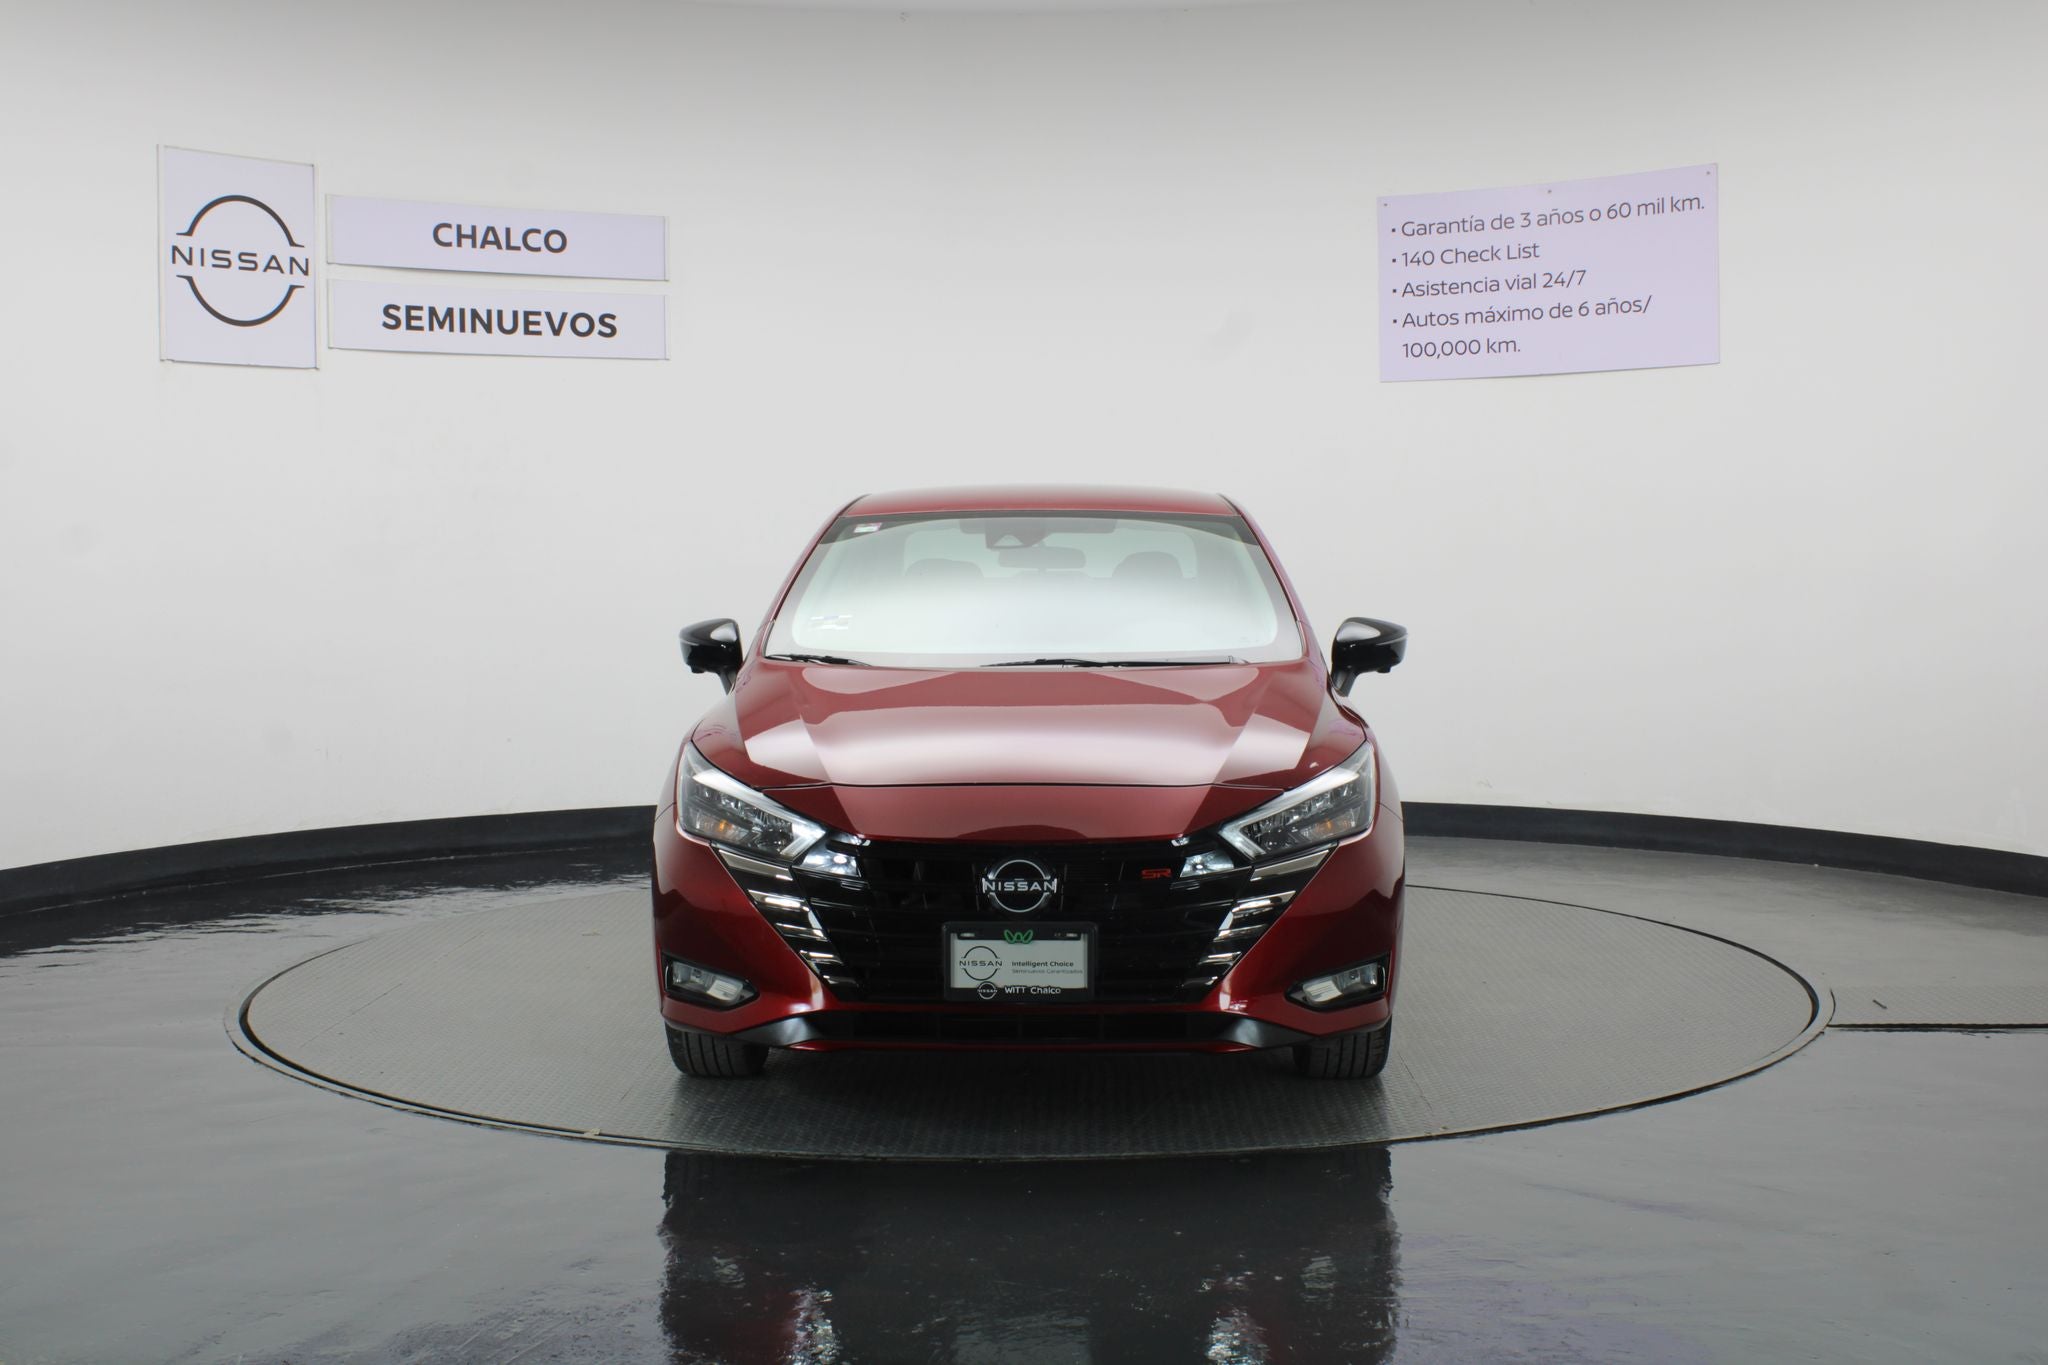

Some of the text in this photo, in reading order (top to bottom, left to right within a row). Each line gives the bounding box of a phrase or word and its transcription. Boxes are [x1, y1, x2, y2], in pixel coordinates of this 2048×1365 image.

[1401, 195, 1705, 237] Garantía de 3 años o 60 mil km.
[433, 223, 568, 254] CHALCO
[172, 245, 309, 277] NISSAN
[1401, 242, 1541, 268] 140 Check List
[1401, 269, 1587, 298] Asistencia vial 24/7
[382, 303, 618, 339] SEMINUEVOS
[1401, 295, 1653, 329] Autos máximo de 6 años/
[1401, 337, 1521, 360] 100,000 km.
[983, 879, 1057, 892] NISSAN
[1141, 868, 1173, 879] SR
[1011, 960, 1049, 968] Intelligent
[1004, 986, 1062, 995] WITT Chalco
